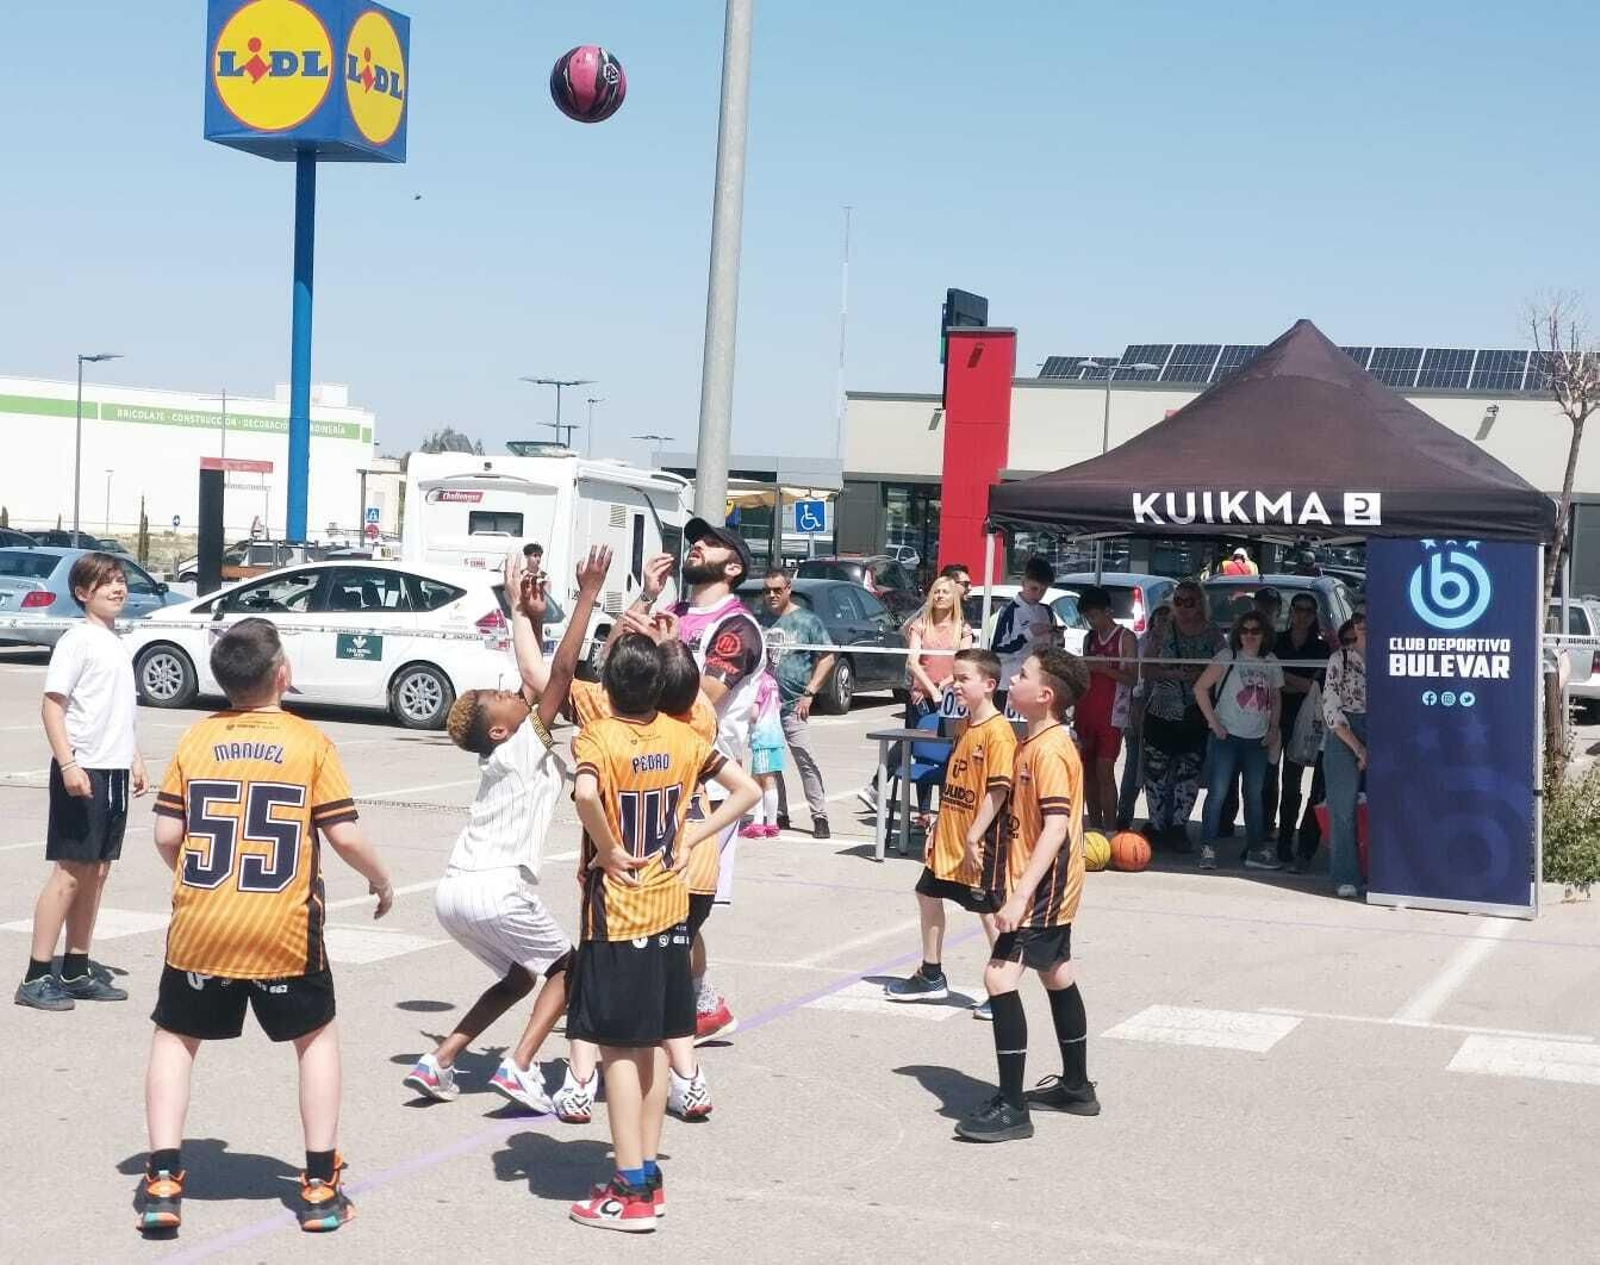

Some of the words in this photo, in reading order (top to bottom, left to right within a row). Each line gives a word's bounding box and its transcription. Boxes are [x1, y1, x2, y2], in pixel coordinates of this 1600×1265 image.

[1132, 491, 1331, 525] KUIKMA
[1389, 638, 1425, 651] CLUB
[1428, 638, 1511, 652] DEPORTIVO
[1389, 653, 1510, 678] BULEVAR
[214, 742, 283, 764] MANUEL
[182, 779, 307, 893] 55
[618, 784, 682, 882] 14
